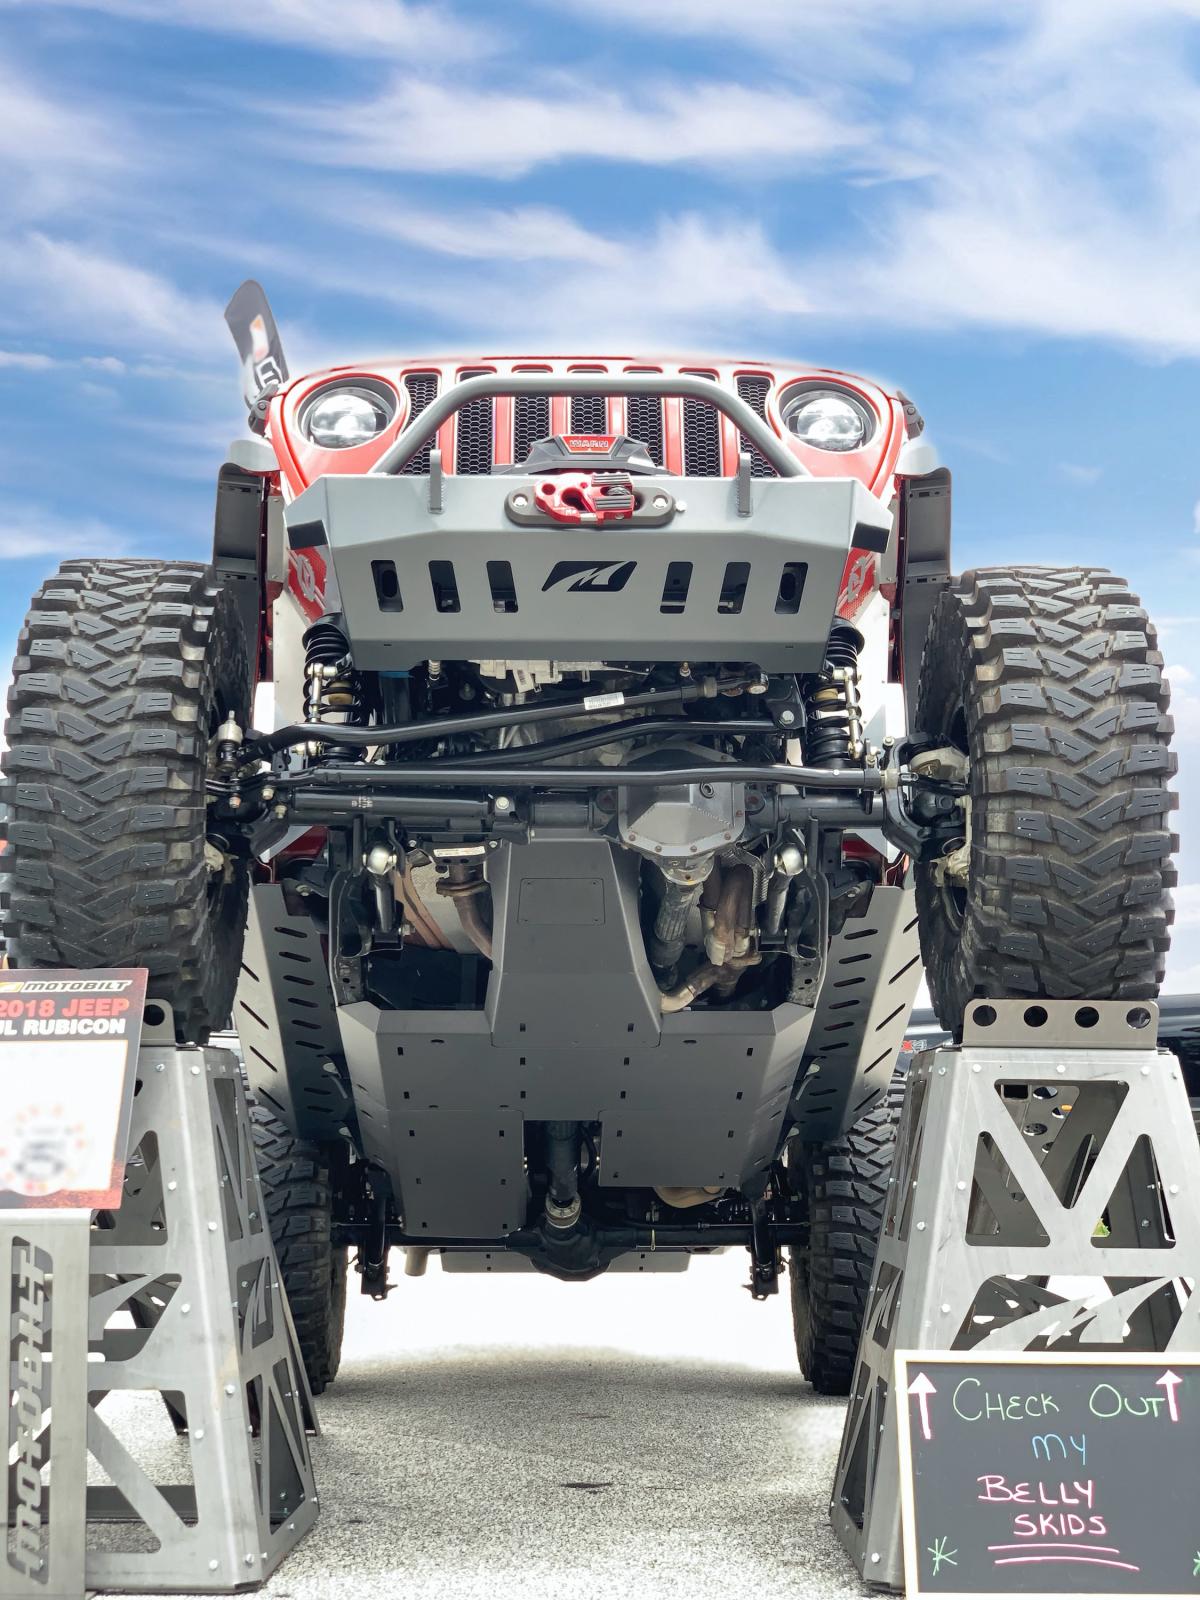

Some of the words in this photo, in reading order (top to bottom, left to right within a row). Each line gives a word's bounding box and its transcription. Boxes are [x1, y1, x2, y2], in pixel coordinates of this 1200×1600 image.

[24, 981, 129, 991] MOTOBILT
[0, 999, 56, 1018] 2018
[62, 998, 130, 1017] JEEP
[23, 1018, 126, 1036] RUBICON
[15, 1246, 44, 1575] MOTOBILT
[953, 1377, 1060, 1421] CHECK
[1089, 1383, 1165, 1418] OUT
[976, 1475, 1093, 1509] BELLY
[1013, 1513, 1107, 1536] SKIDS
